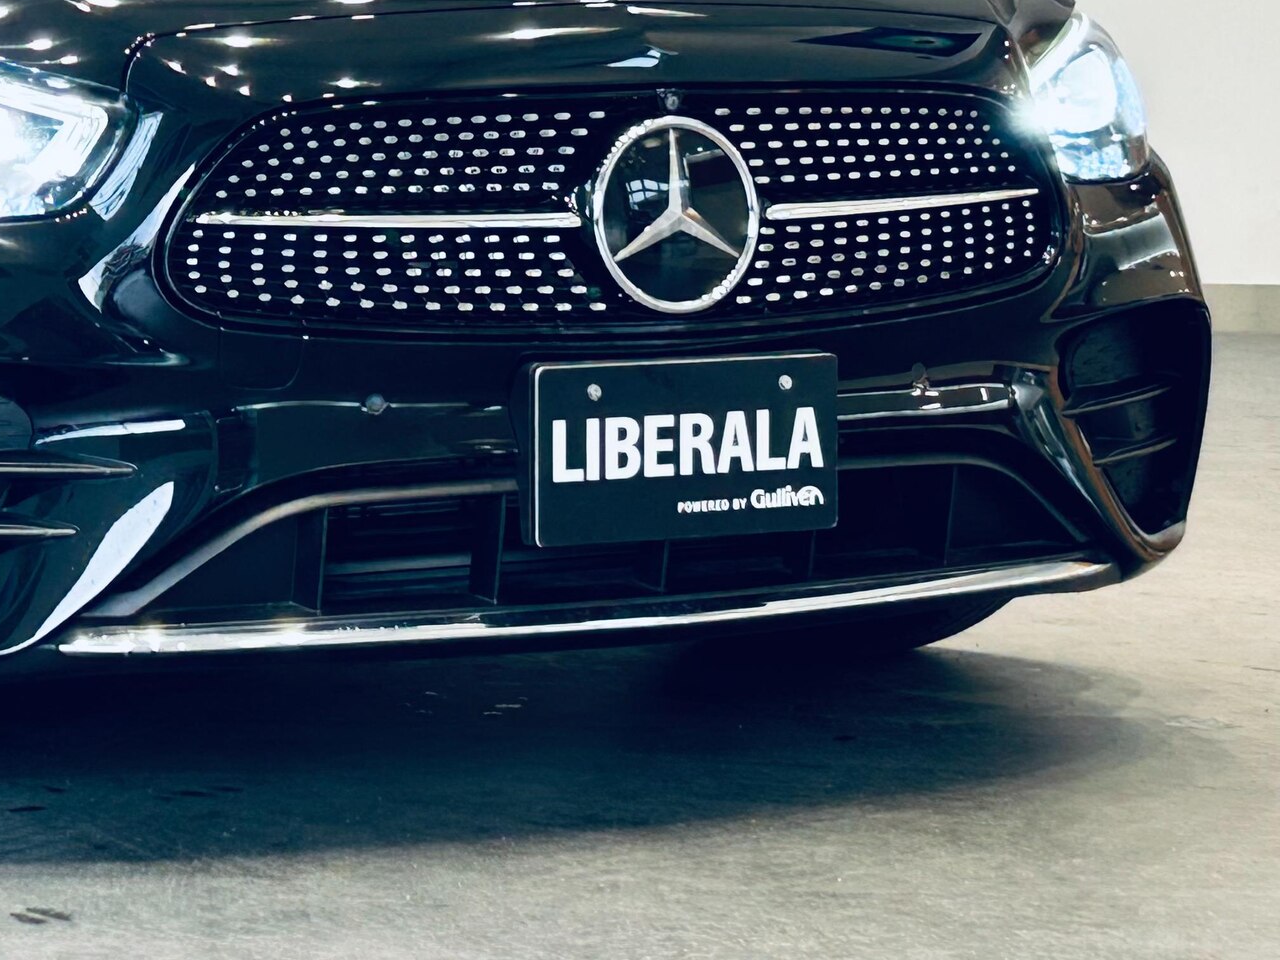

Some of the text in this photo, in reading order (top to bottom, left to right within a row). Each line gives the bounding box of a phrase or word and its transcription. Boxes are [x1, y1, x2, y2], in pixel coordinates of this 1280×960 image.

[552, 406, 824, 483] LIBERALA
[677, 485, 825, 514] POWERED BY Gulliver
